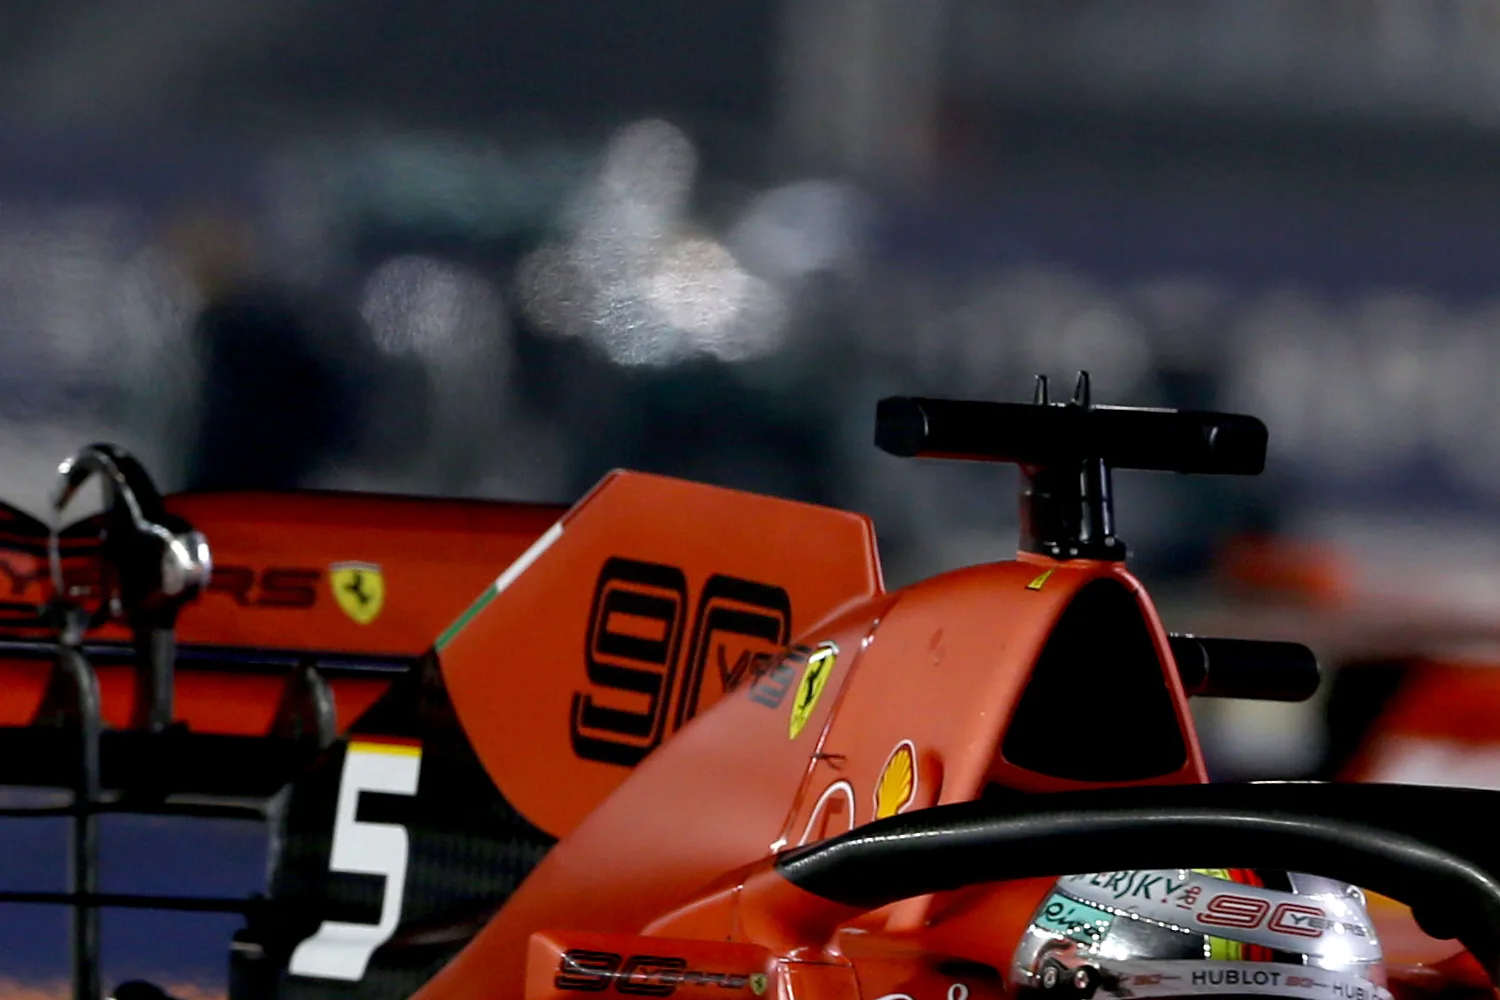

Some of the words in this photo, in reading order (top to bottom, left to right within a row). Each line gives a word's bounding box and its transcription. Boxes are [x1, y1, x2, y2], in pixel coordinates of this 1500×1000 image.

[288, 734, 424, 981] 5
[1197, 894, 1325, 939] 90
[554, 948, 687, 997] 90
[1192, 969, 1281, 986] HUBLOT
